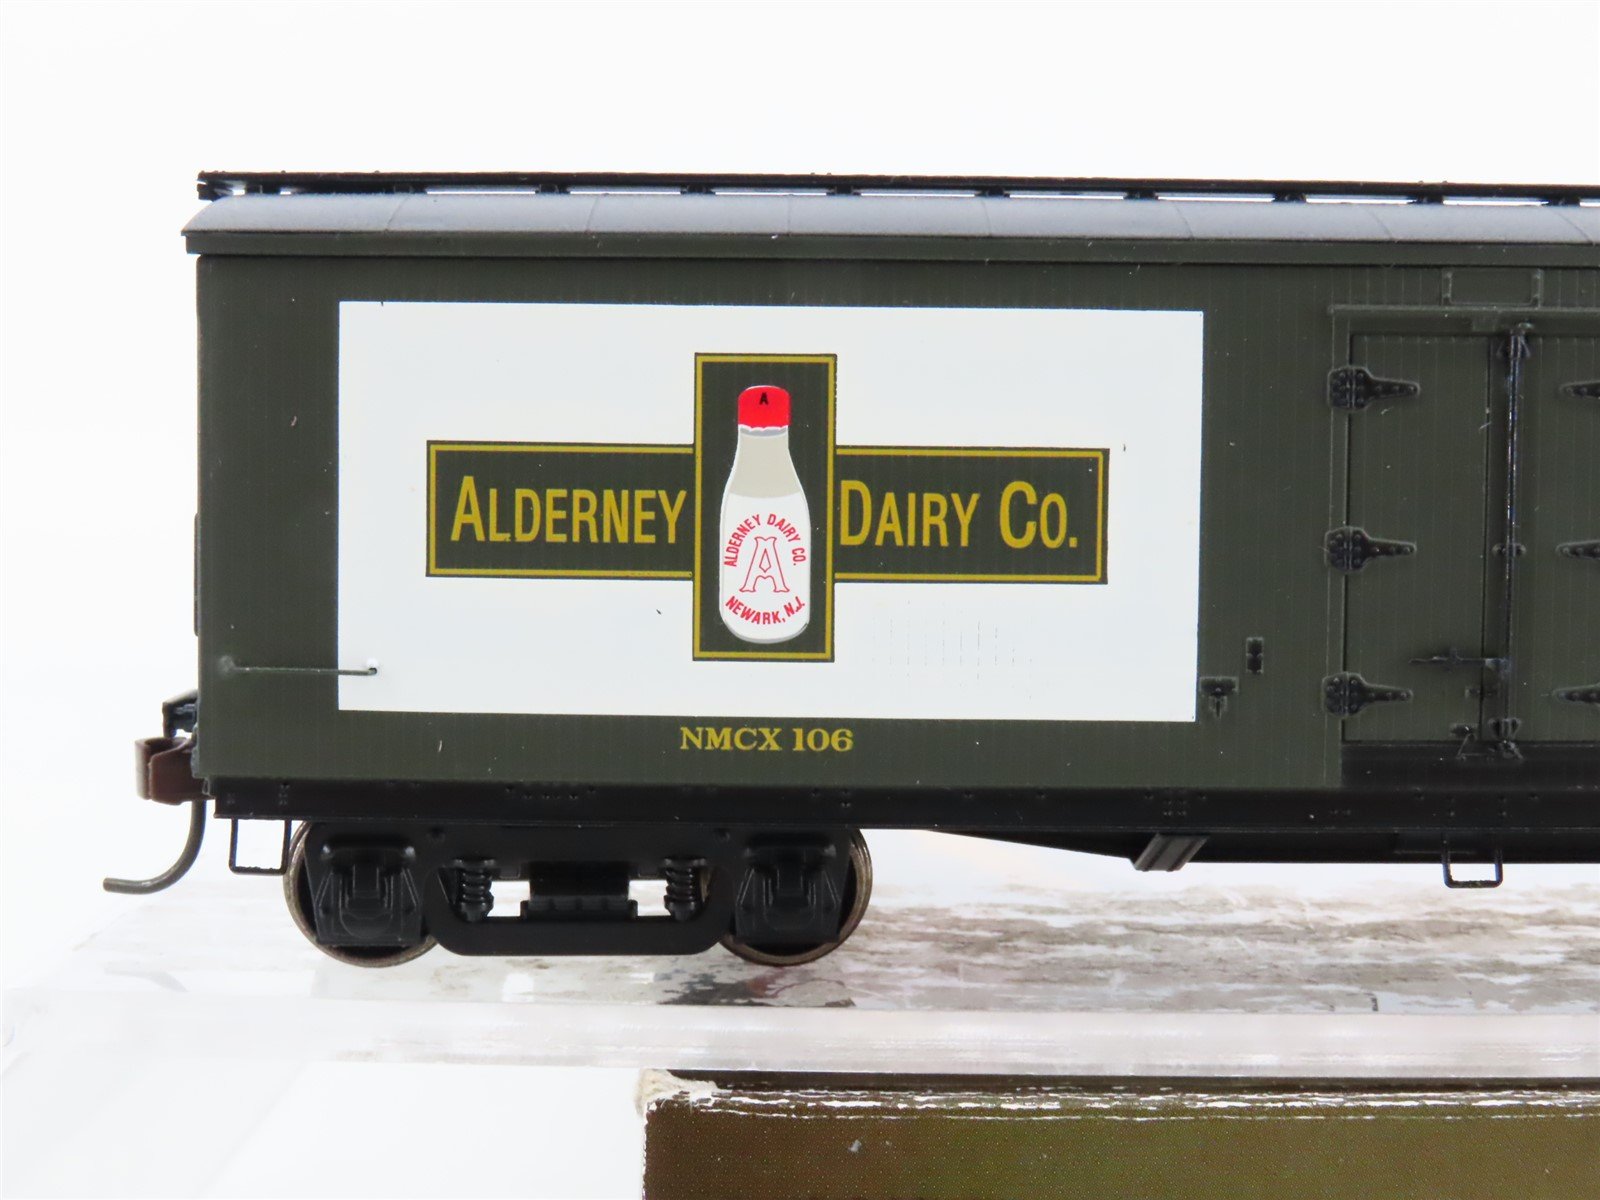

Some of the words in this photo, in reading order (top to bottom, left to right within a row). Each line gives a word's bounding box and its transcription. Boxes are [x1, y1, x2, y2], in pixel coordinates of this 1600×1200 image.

[758, 391, 769, 406] A
[451, 476, 686, 544] ALDERNEY
[840, 480, 980, 548] DAIRY
[999, 480, 1079, 550] CO.
[723, 513, 762, 567] ALDERNEY
[767, 513, 801, 542] DAIRY
[791, 547, 807, 566] CO.
[739, 536, 790, 593] A
[725, 595, 786, 625] NEWARK,
[783, 595, 806, 619] N.J.
[679, 726, 783, 751] NMCX
[792, 727, 854, 752] 106
